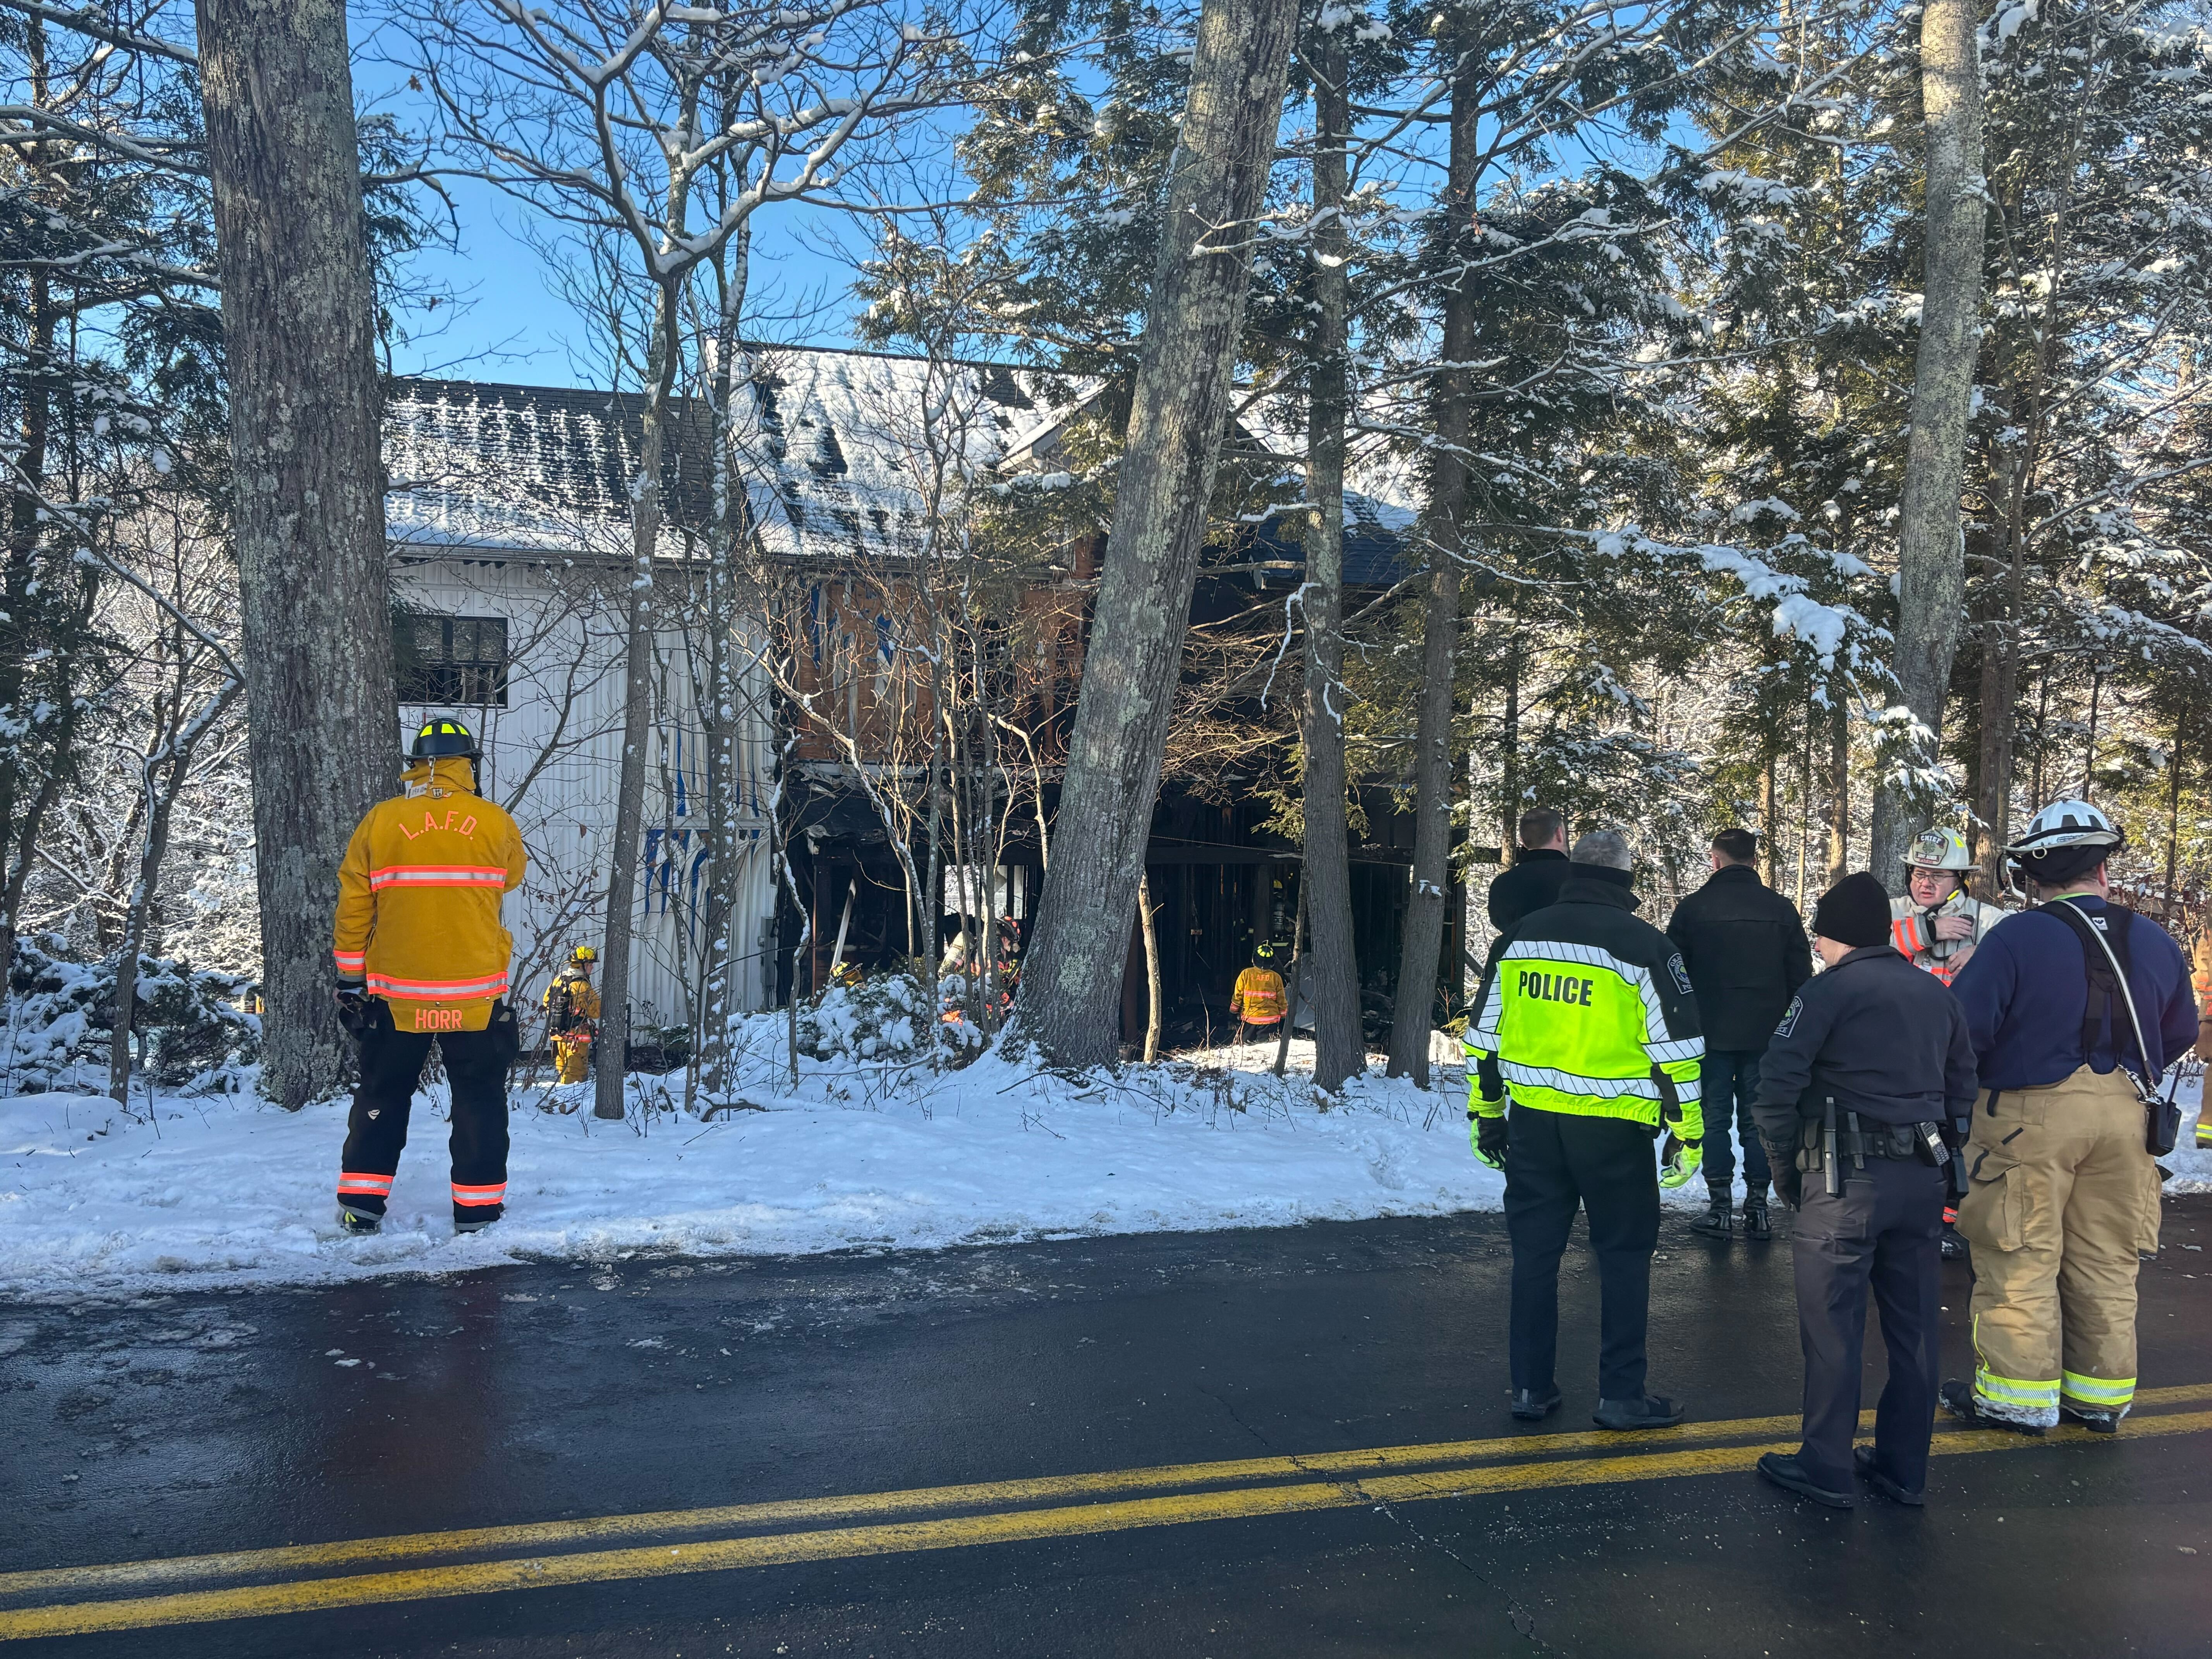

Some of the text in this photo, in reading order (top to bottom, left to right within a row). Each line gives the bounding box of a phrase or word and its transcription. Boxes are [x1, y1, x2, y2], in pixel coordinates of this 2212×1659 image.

[398, 810, 477, 840] L.A.F.D.
[1920, 835, 1942, 843] CHIEF
[1518, 970, 1594, 1007] POLICE
[415, 1008, 462, 1029] HORR
